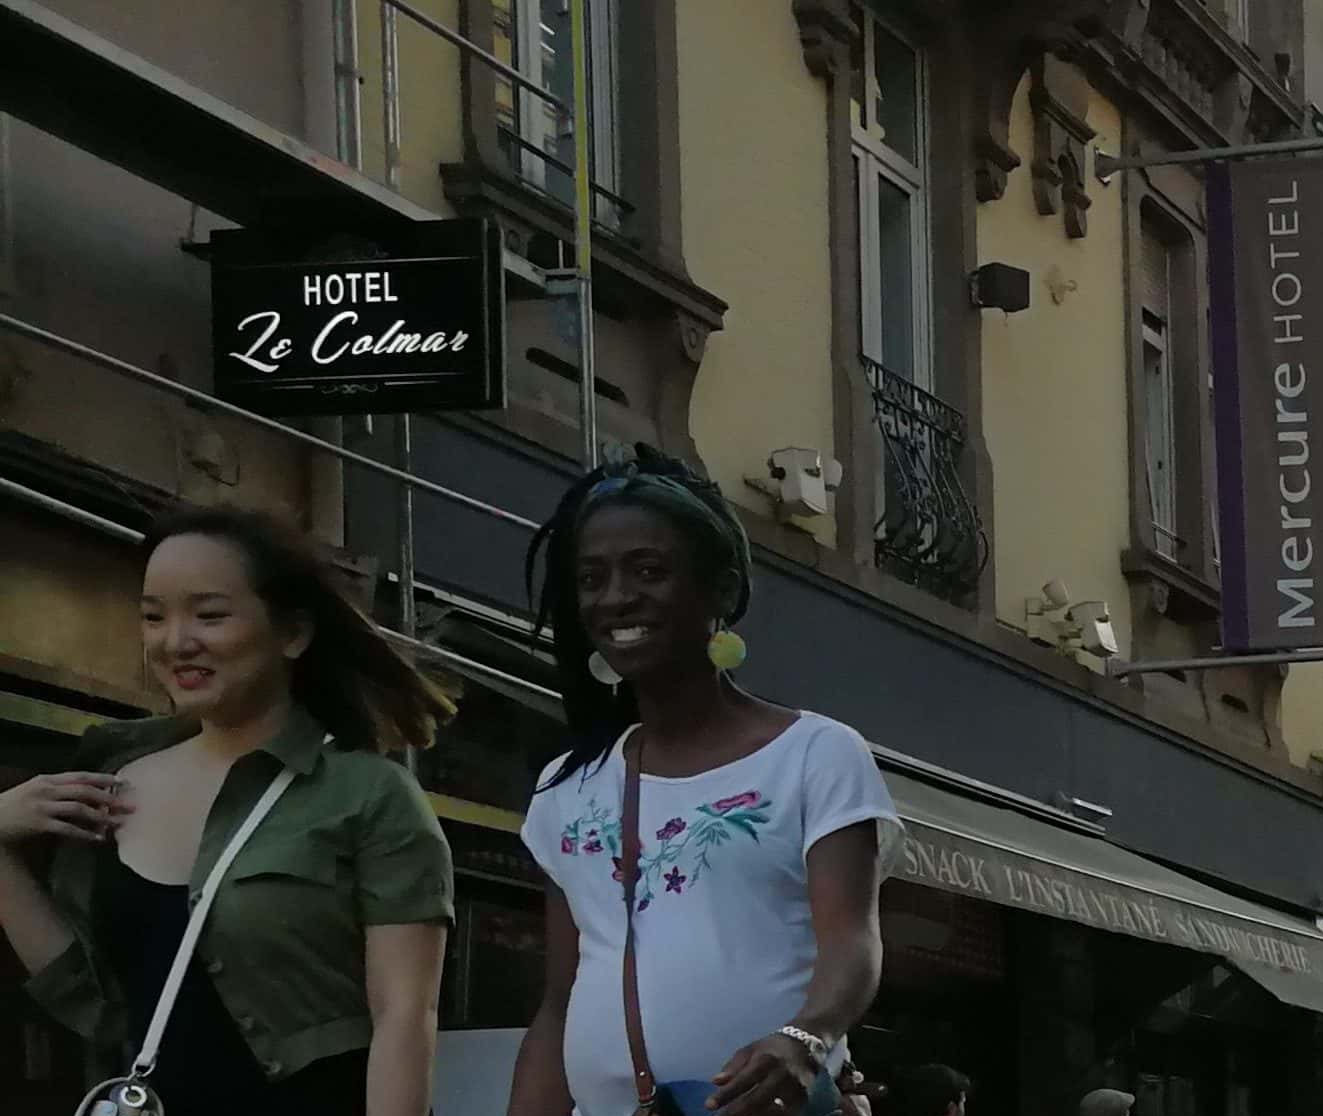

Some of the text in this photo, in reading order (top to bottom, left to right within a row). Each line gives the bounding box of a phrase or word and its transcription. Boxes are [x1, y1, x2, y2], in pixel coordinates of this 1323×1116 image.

[303, 271, 399, 306] HOTEL
[229, 310, 469, 373] Le Colmar
[1267, 180, 1315, 627] Mercure HOTEL
[903, 838, 992, 894] SNACK
